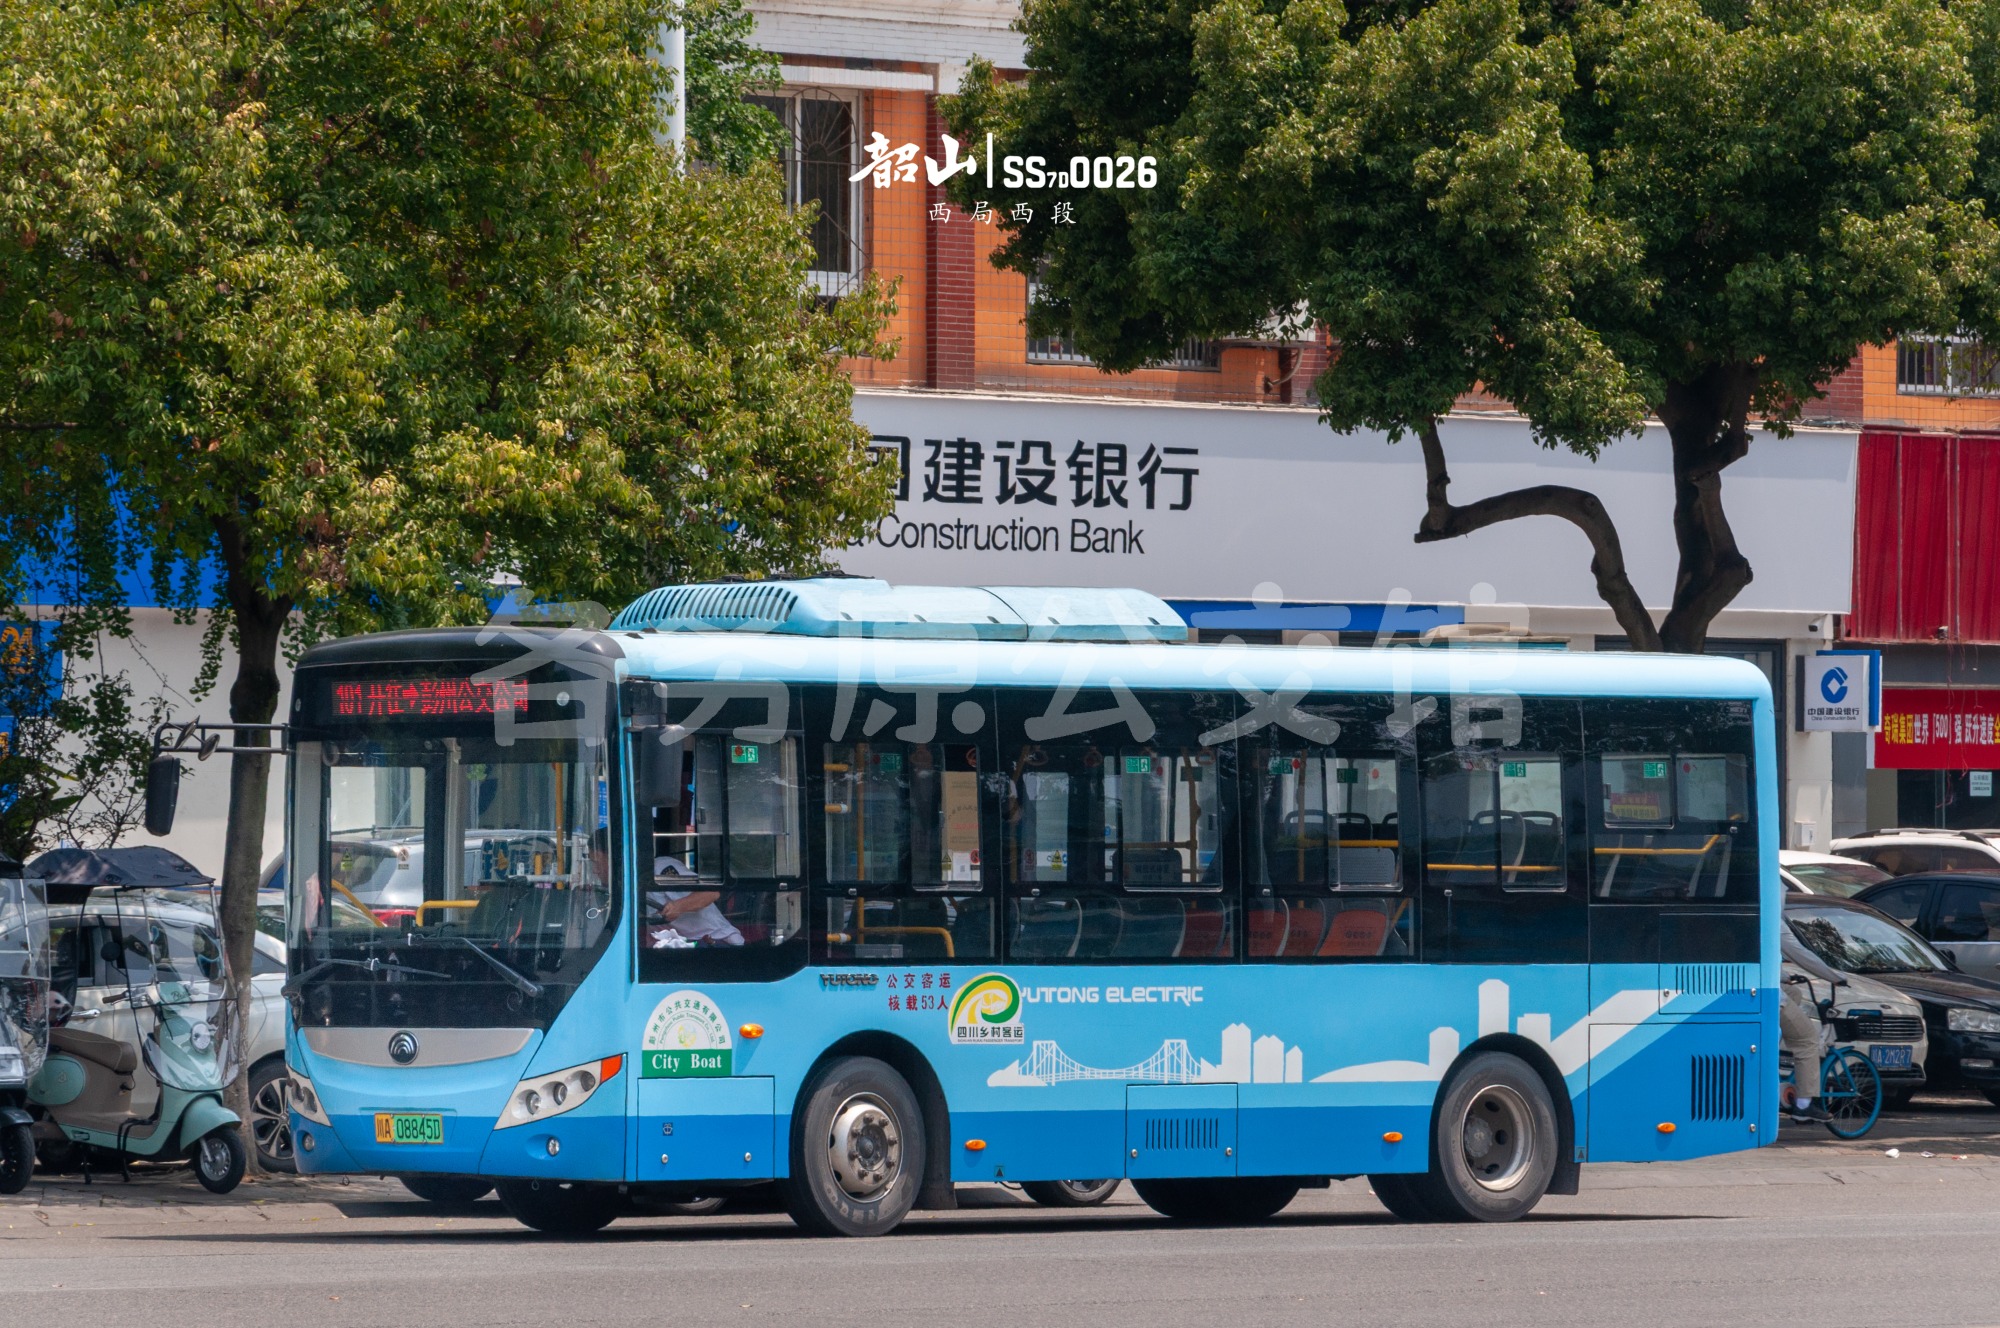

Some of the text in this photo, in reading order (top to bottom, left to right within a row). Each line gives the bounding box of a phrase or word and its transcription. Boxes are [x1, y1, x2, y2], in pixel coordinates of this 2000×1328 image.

[877, 512, 1146, 555] Construction Bank
[1807, 707, 1860, 716] 中国建设银行
[820, 973, 880, 987] YUTONG
[887, 973, 951, 989] 公交客运
[888, 995, 949, 1011] 核载53人
[957, 1026, 1024, 1038] 四川乡村客运
[651, 1053, 722, 1073] City Boat
